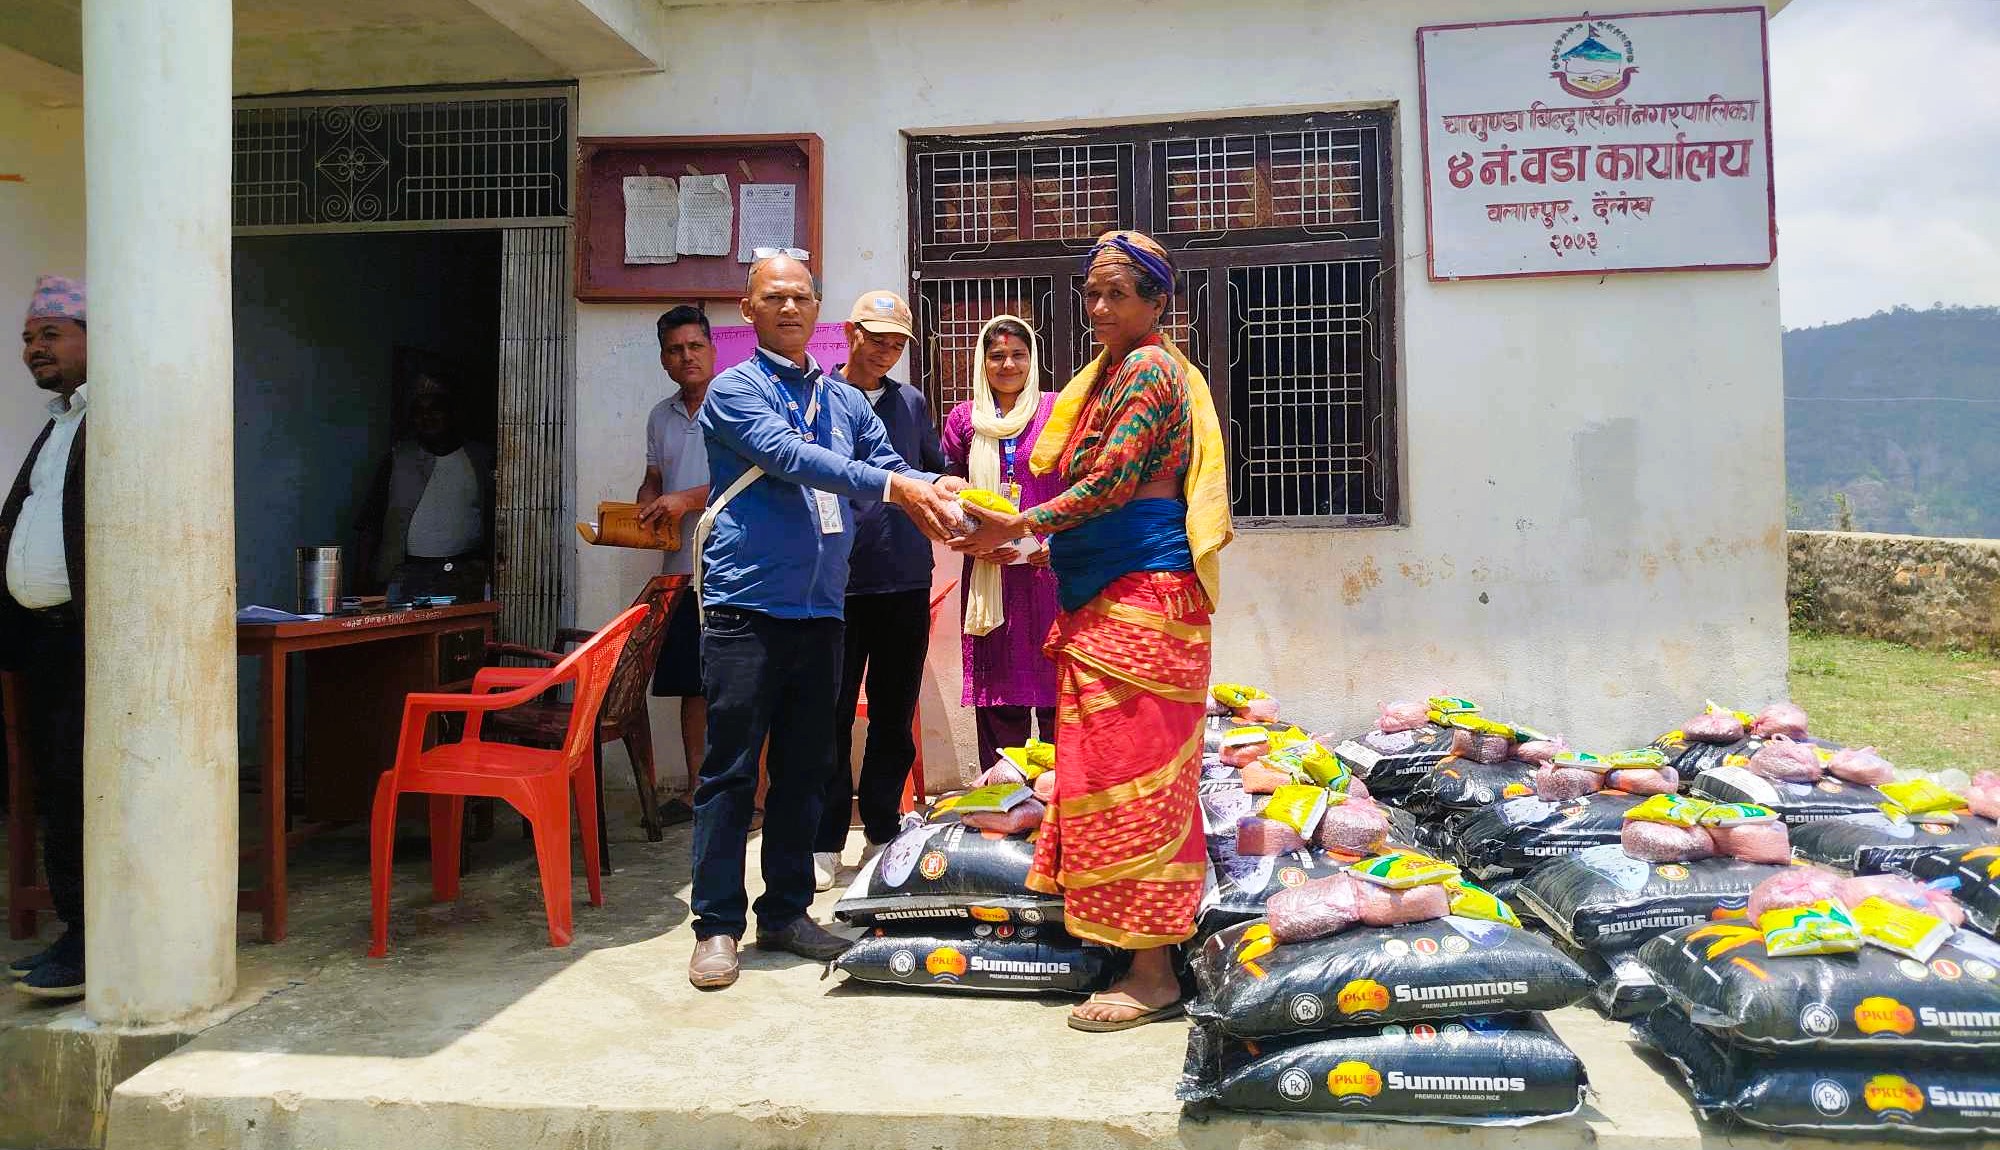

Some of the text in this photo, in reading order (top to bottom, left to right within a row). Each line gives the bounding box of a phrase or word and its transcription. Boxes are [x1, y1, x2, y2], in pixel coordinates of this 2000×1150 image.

[1633, 94, 1760, 128] नगरपालिका
[1520, 146, 1591, 184] वडा
[1595, 132, 1754, 182] कार्यालय
[1550, 232, 1599, 257] २०७३
[874, 907, 969, 921] Summmos
[970, 955, 1071, 974] Summmos
[1343, 989, 1385, 1004] PKU'S
[1394, 980, 1529, 1003] Summmos
[1334, 1074, 1376, 1085] PKU'S
[1388, 1071, 1526, 1092] Summmos
